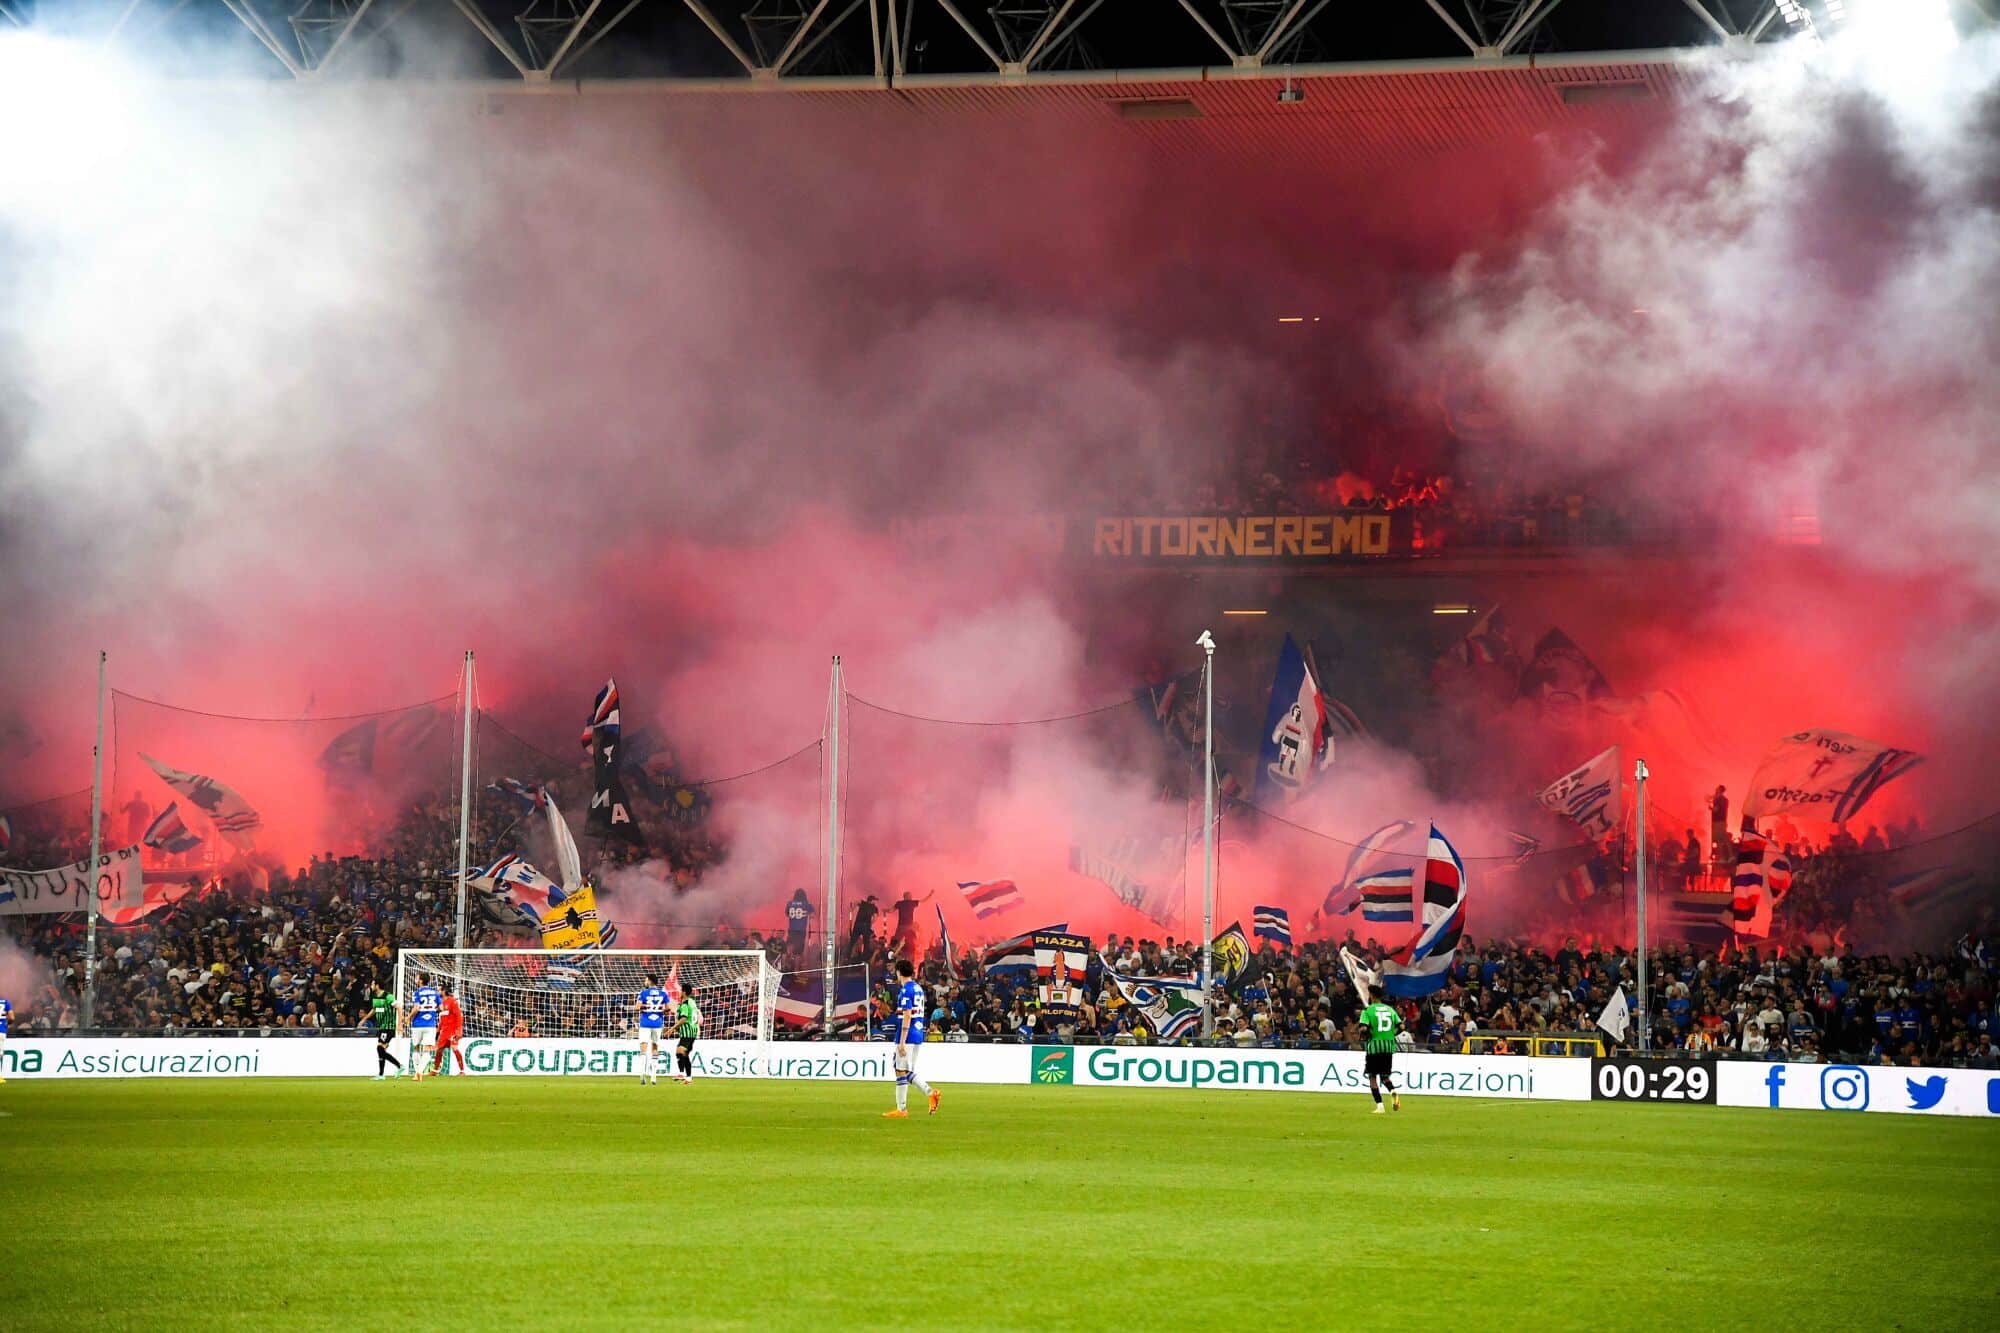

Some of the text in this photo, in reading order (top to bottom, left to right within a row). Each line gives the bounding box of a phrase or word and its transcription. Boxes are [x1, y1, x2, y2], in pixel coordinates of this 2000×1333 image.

[1094, 515, 1391, 556] RITORNEREMO
[1035, 936, 1085, 948] PIAZZA
[1375, 1011, 1392, 1032] 15
[56, 1048, 259, 1074] Assicurazioni
[1088, 1048, 1534, 1094] Groupama Asscurazioni
[1599, 1064, 1710, 1100] 00:29
